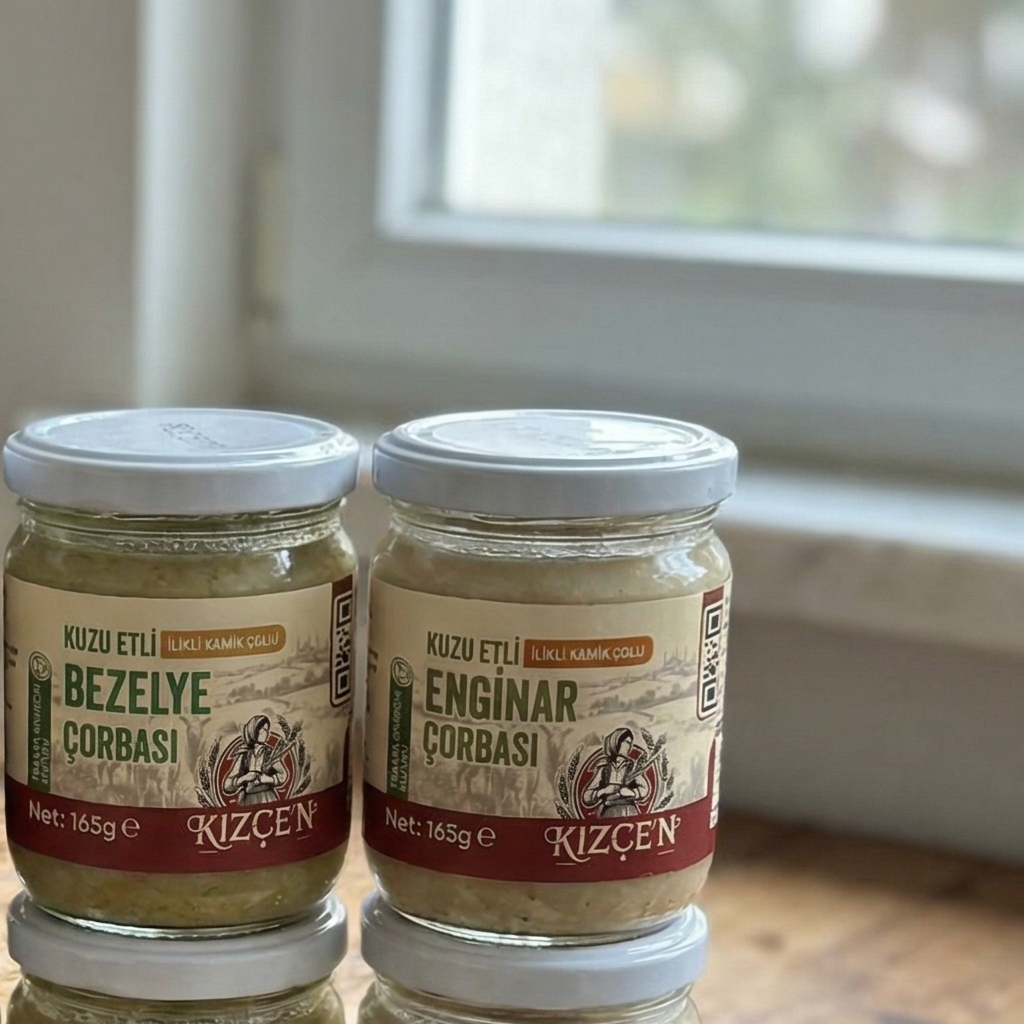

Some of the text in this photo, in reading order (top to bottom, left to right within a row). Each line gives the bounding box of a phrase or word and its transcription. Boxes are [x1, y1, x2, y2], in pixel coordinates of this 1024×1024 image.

[63, 624, 157, 657] KUZU ETLİ
[427, 630, 520, 666] KUZU ETLİ
[64, 663, 211, 715] BEZELYE
[425, 664, 578, 723] ENGİNAR
[63, 720, 178, 765] ÇORBASI
[422, 721, 539, 768] ÇORBASI
[29, 799, 65, 829] Net:
[71, 811, 116, 841] 165g
[385, 807, 422, 837] Net:
[426, 819, 472, 850] 165g
